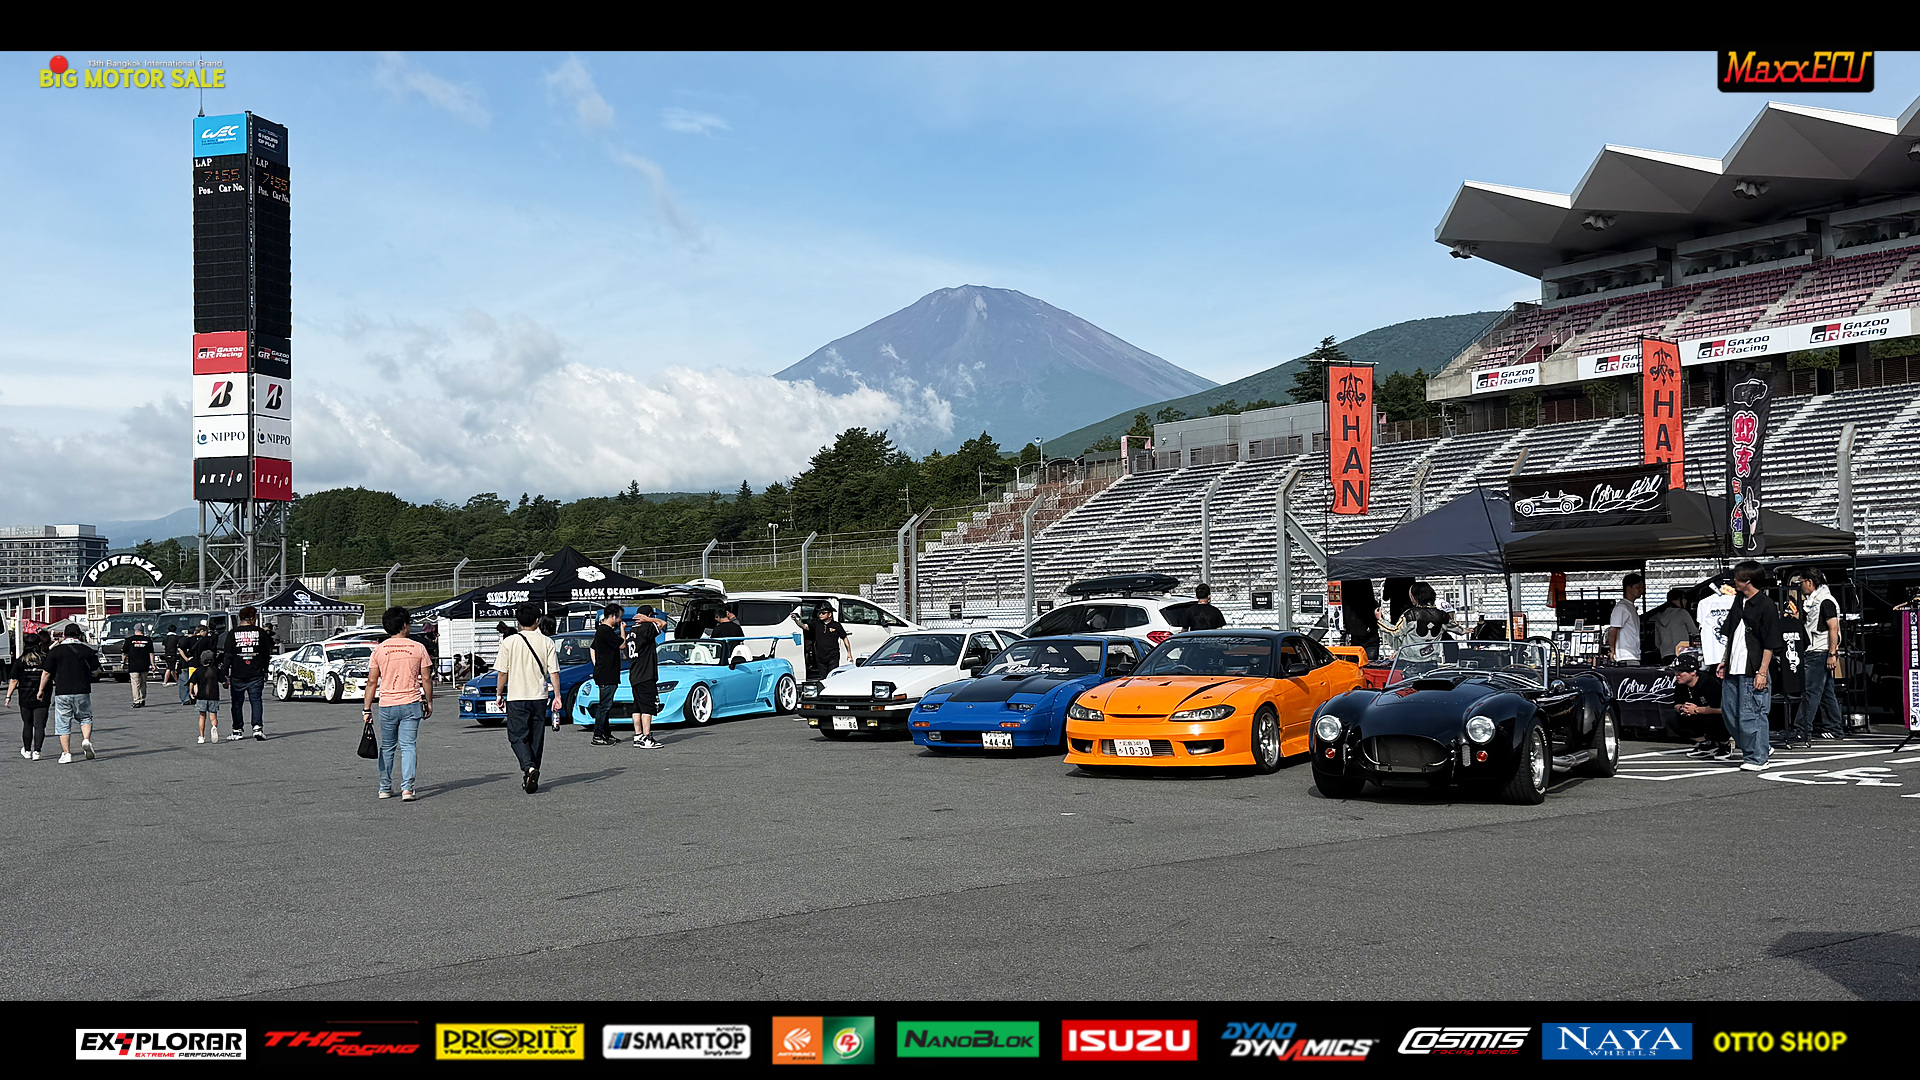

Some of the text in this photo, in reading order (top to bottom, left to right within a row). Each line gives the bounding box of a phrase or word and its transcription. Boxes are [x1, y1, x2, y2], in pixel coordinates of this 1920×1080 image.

[202, 126, 239, 138] WEC
[195, 158, 212, 167] LAP
[256, 157, 268, 168] LAP
[204, 168, 240, 182] 7:55
[263, 172, 288, 191] 7:55
[198, 186, 213, 195] Pos.
[233, 183, 244, 192] No.
[272, 190, 281, 200] Car
[1844, 318, 1890, 330] GAZOO
[1728, 335, 1770, 346] GAZOO
[1810, 327, 1888, 344] GR Racing
[197, 351, 215, 359] GR
[258, 351, 270, 359] GR
[1697, 344, 1768, 359] GR Racing
[1501, 369, 1535, 378] GAZOO
[1594, 362, 1619, 374] GR
[1476, 376, 1534, 389] GR Racing
[1653, 390, 1674, 463] HA
[211, 431, 245, 442] NIPPO
[267, 433, 291, 445] NIPPO
[1342, 414, 1364, 507] HAN
[88, 555, 163, 582] POTENZA
[571, 588, 605, 600] BLACK
[1124, 746, 1150, 755] 10-30
